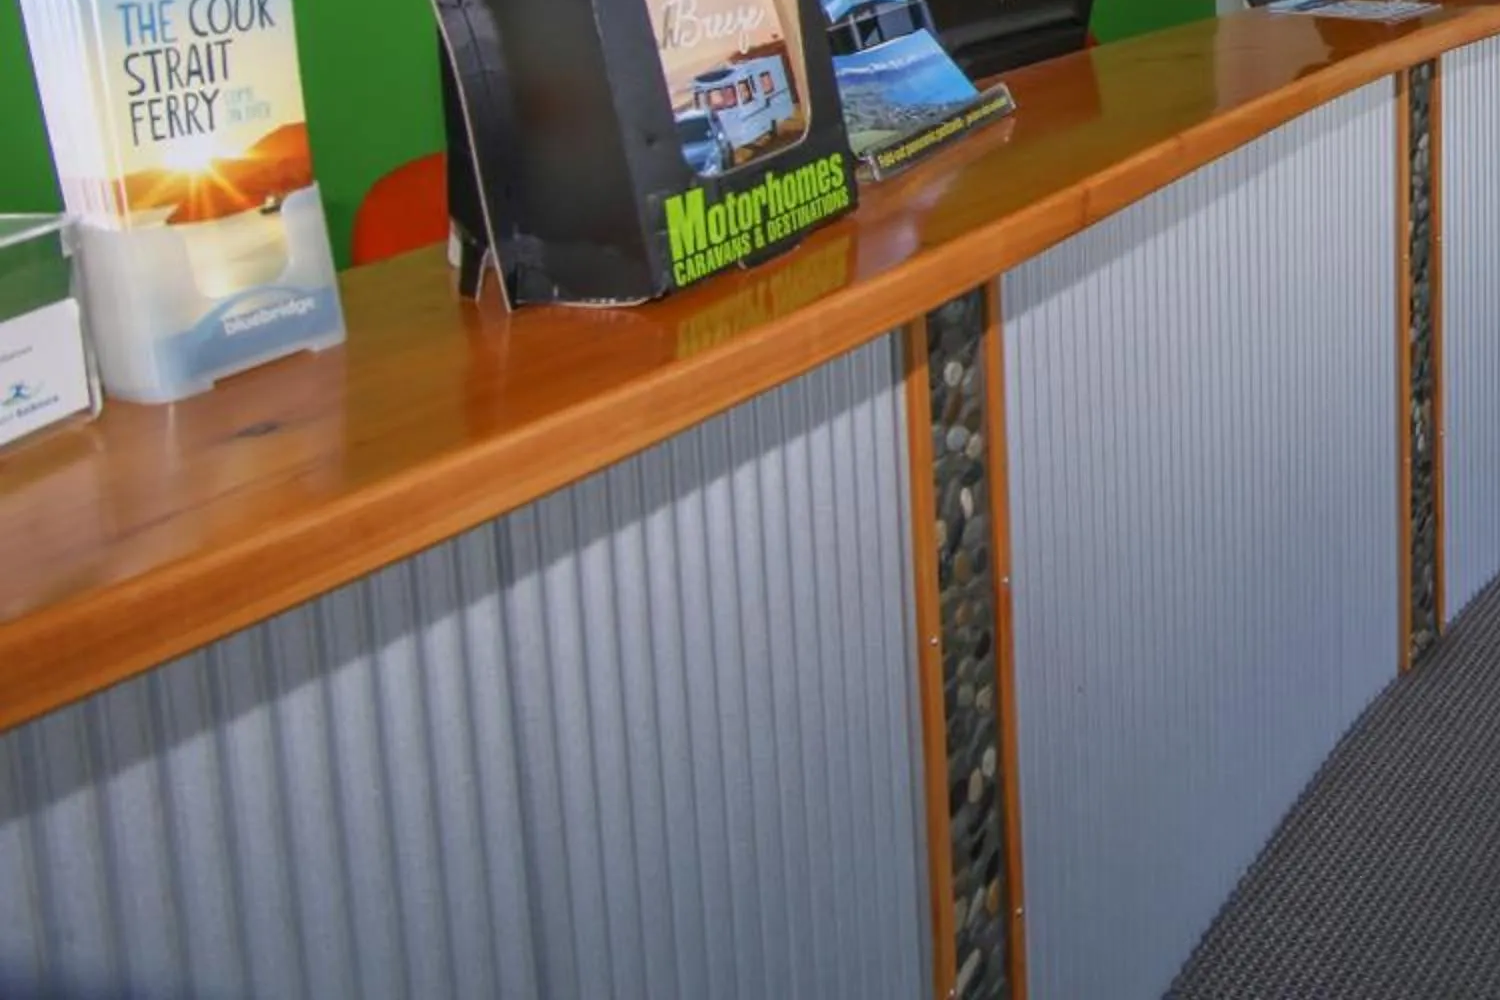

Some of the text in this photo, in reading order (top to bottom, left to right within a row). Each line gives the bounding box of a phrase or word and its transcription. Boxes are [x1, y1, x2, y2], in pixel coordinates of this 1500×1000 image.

[123, 38, 234, 97] STRAIT
[129, 88, 220, 147] FERRY
[665, 152, 845, 262] Motorhomes
[673, 186, 849, 288] CARAVANS & DESTINATIONS
